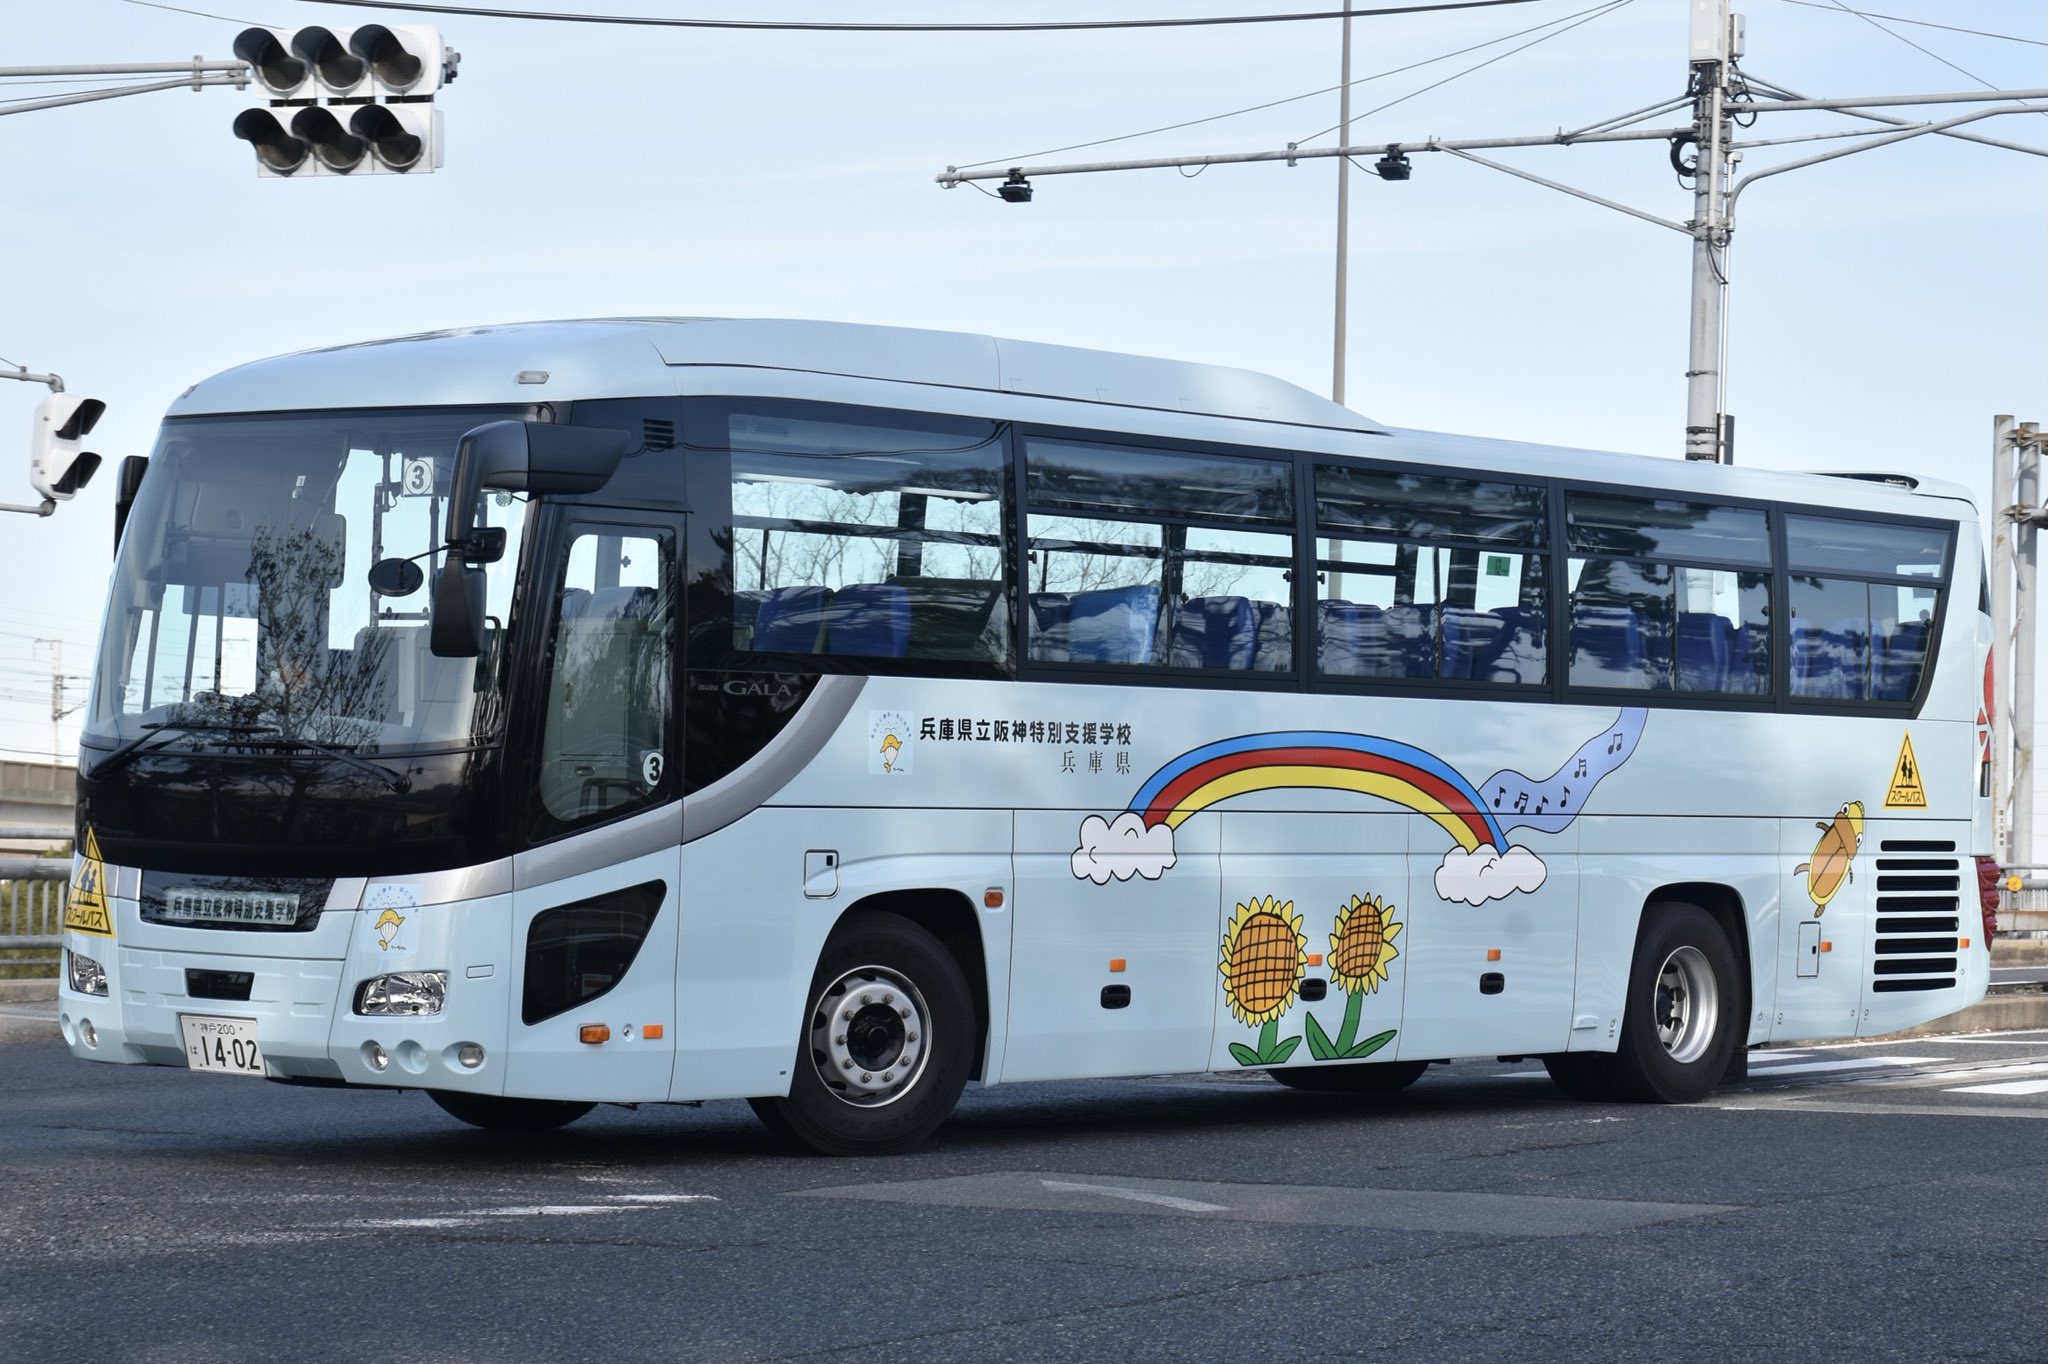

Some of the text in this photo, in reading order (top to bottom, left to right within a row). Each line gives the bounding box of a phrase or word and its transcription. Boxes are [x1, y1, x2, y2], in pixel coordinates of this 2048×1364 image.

[411, 465, 425, 490] 3
[723, 680, 792, 696] GALA
[919, 717, 1131, 746] 兵庫県立阪神特別支援学校
[648, 756, 661, 782] 3
[1891, 790, 1921, 803] スクールバス
[66, 906, 103, 928] スクールバス
[201, 1035, 261, 1070] 14-02
